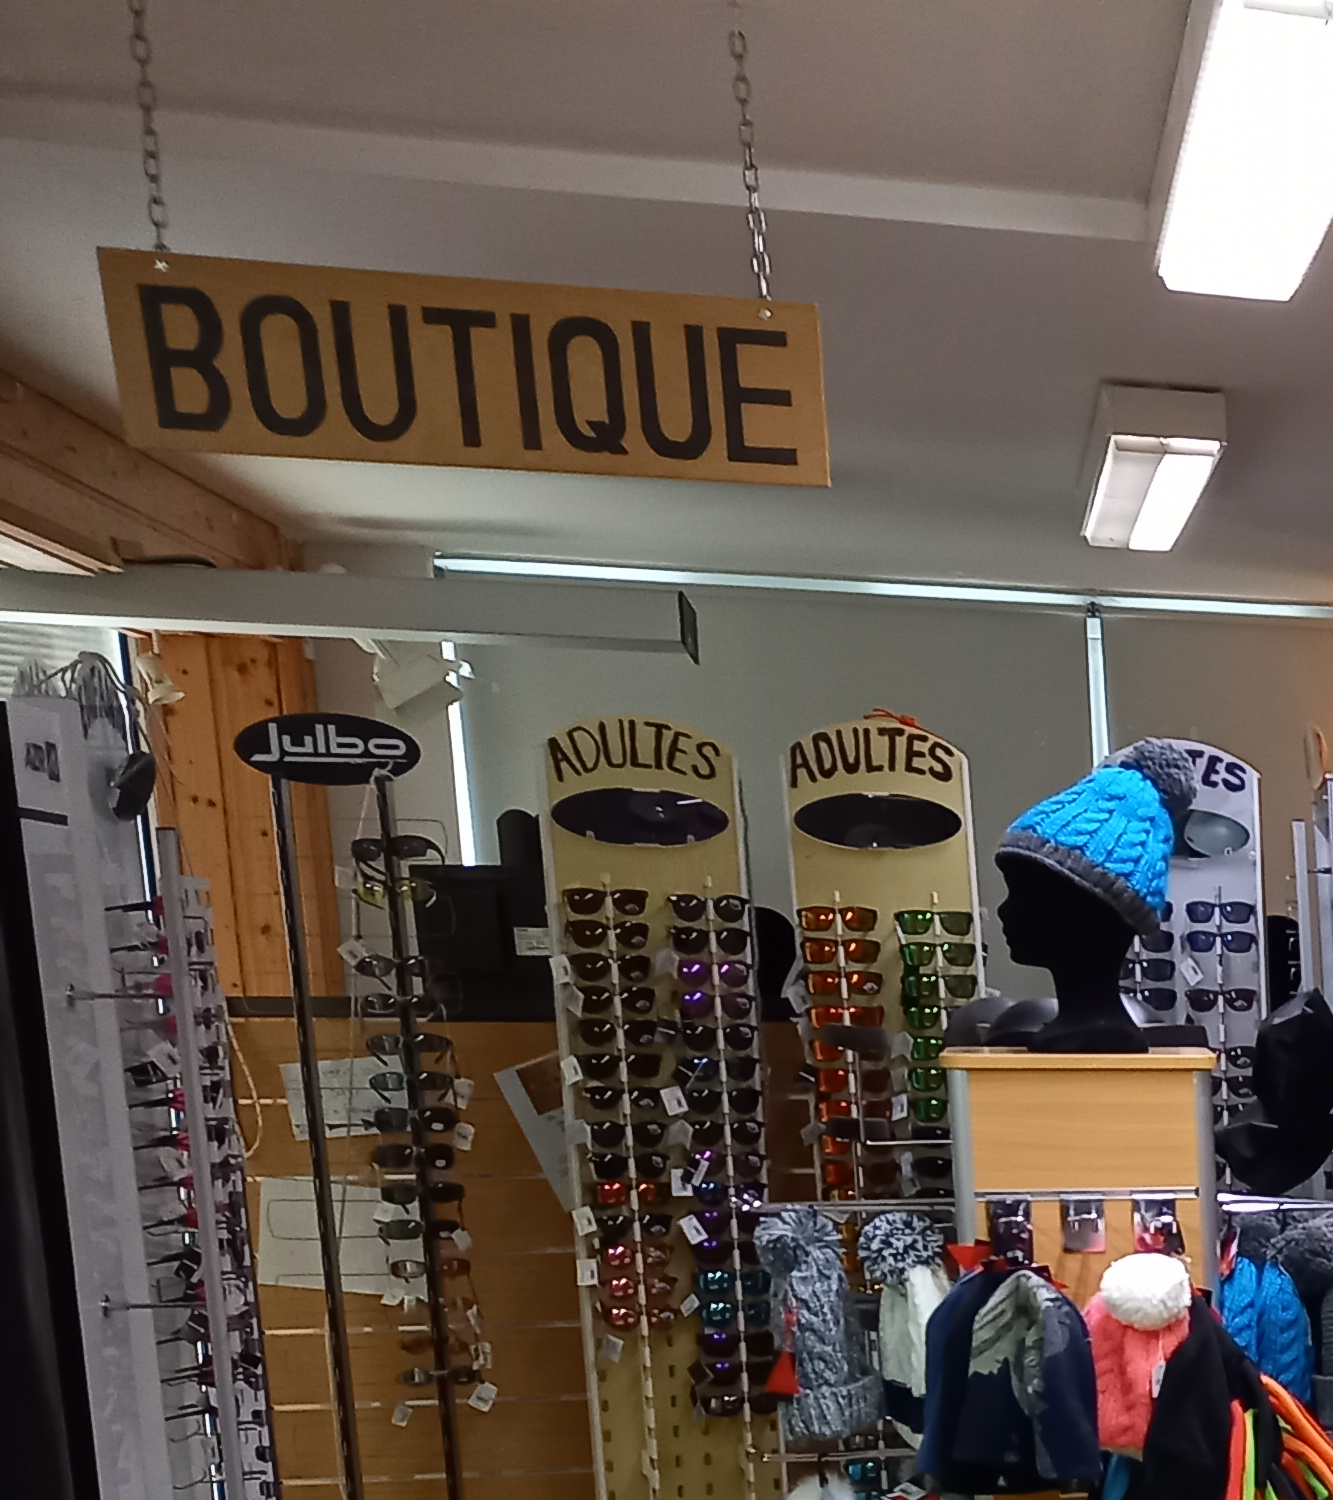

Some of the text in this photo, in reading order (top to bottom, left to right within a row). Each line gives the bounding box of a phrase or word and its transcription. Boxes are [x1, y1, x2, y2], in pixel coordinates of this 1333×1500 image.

[138, 284, 799, 466] BOUTIQUE
[547, 718, 721, 784] ADULTES
[789, 726, 957, 788] ADULTES
